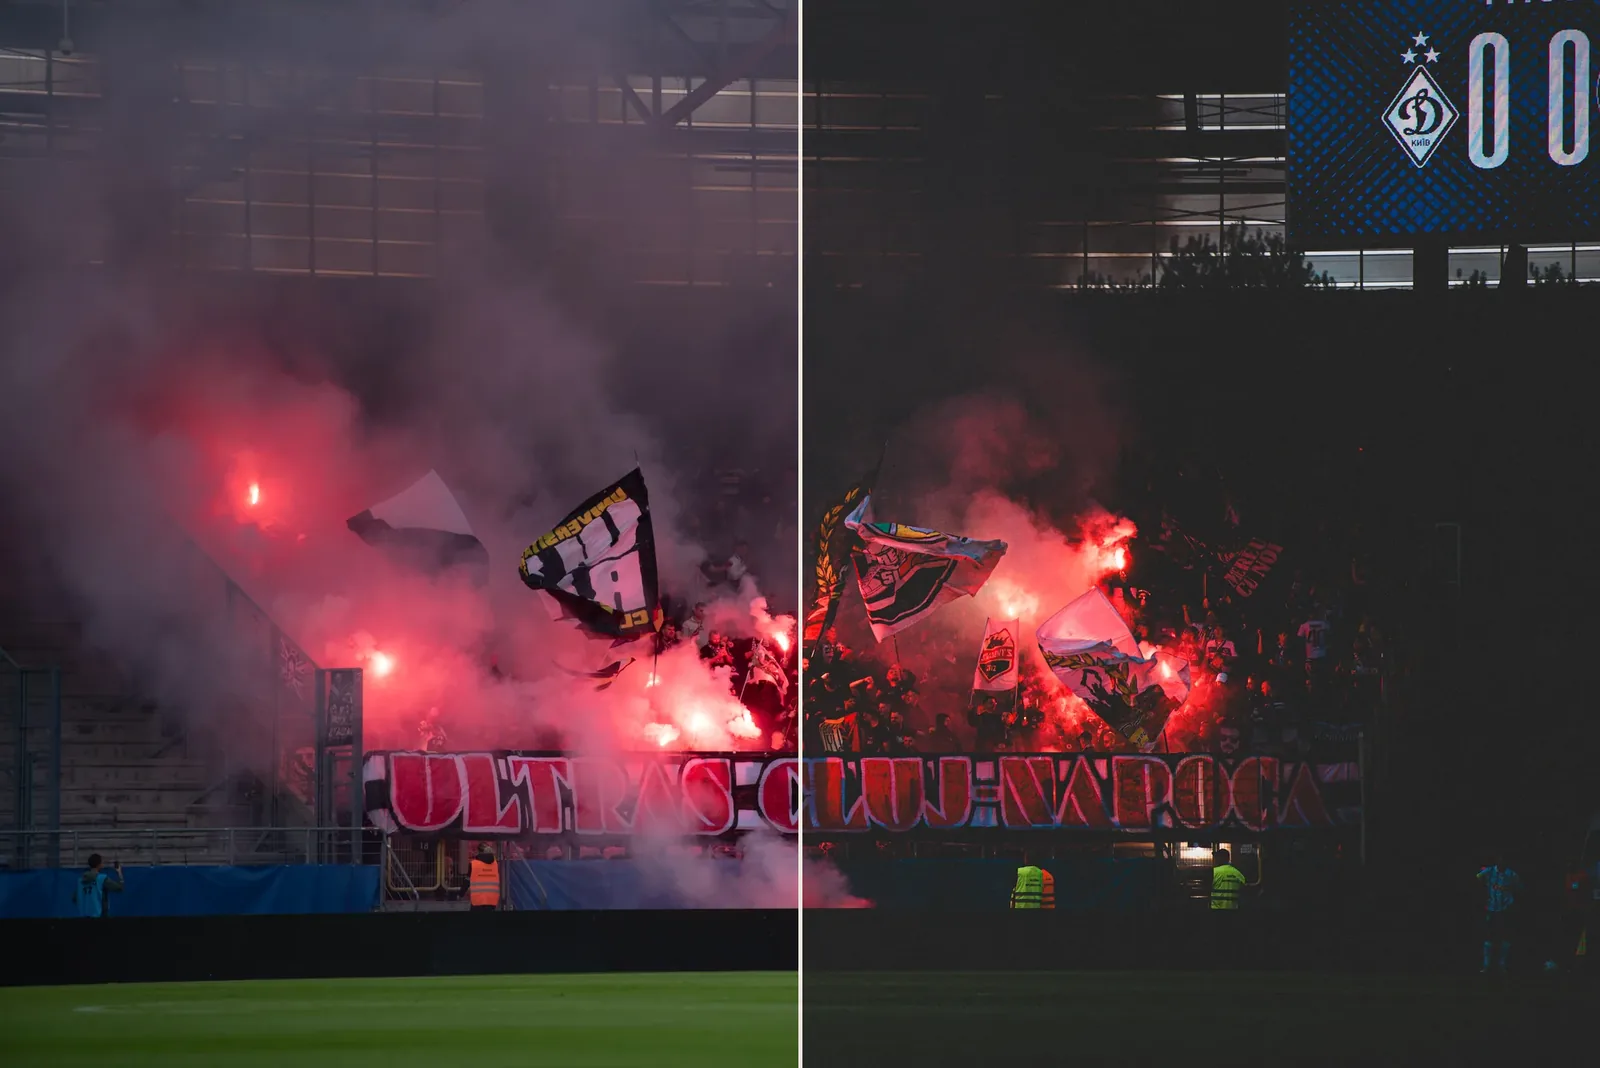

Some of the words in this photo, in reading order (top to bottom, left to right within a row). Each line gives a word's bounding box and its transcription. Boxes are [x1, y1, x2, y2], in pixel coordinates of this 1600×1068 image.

[1468, 31, 1509, 169] 0
[1548, 29, 1590, 166] 0
[389, 752, 737, 836] ULTRAS
